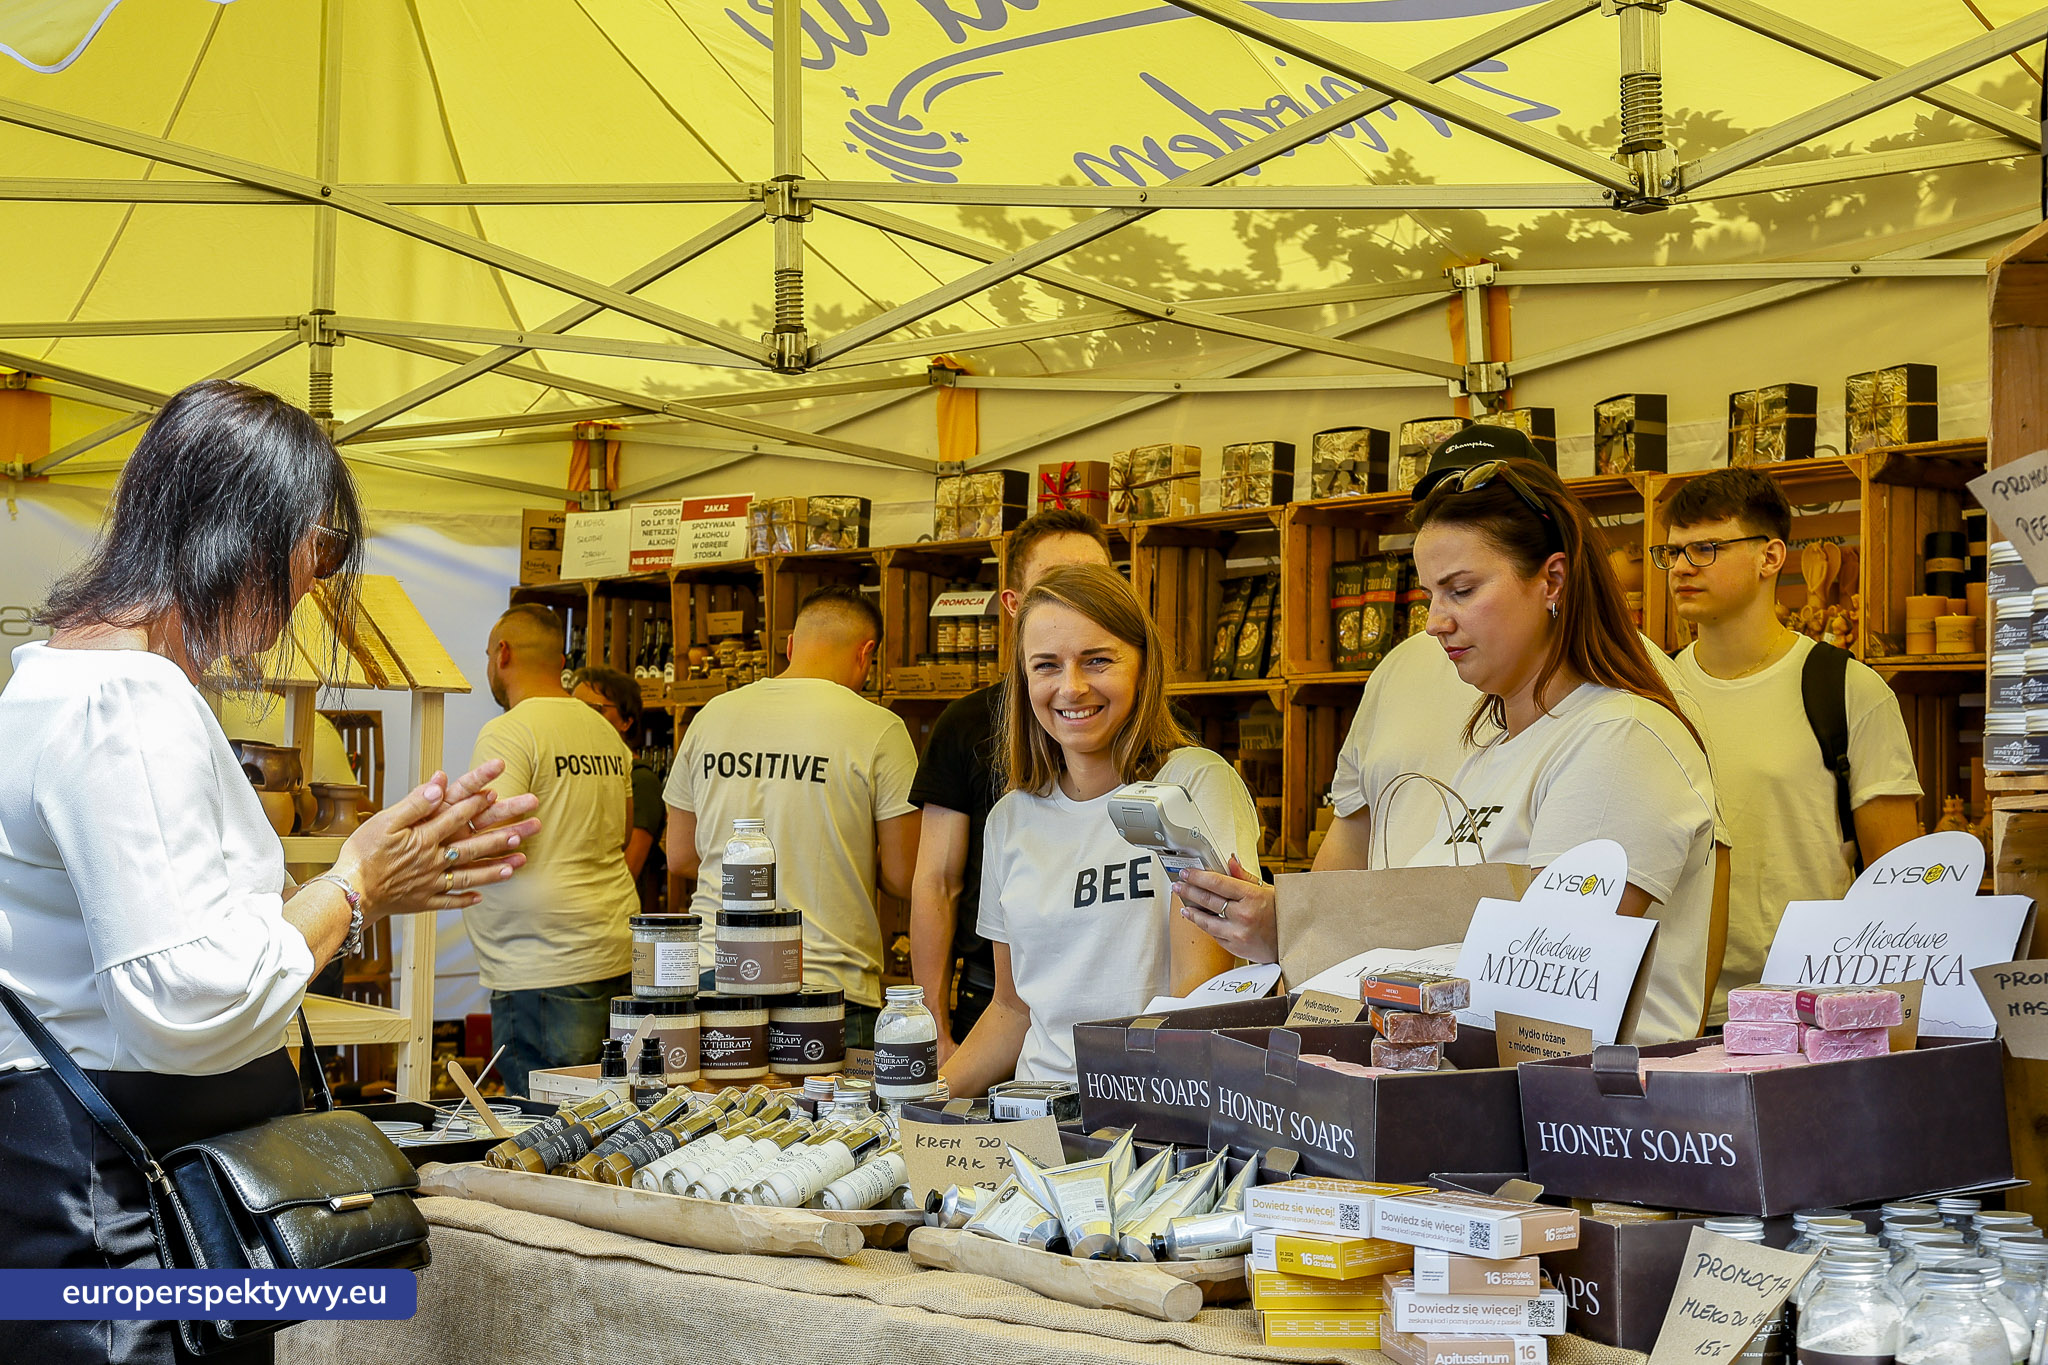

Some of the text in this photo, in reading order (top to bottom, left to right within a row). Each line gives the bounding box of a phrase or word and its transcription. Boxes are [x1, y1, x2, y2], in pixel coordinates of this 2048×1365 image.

[1445, 441, 1495, 454] Champion
[703, 503, 730, 513] ZAKAZ
[691, 521, 736, 530] SPOŻYWANIA
[694, 531, 730, 539] ALKOHOLU
[701, 540, 729, 549] OBRĘBIE
[632, 557, 645, 565] NIE
[693, 551, 722, 559] STOISKA
[937, 598, 985, 607] PROMOCJA
[554, 755, 624, 777] POSITIVE
[704, 752, 829, 784] POSITIVE
[1073, 856, 1155, 909] BEE
[1508, 926, 1592, 963] Miodowe
[1833, 920, 1948, 954] Miodowe
[1478, 953, 1600, 1002] MYDEŁKA
[1796, 953, 1966, 987] MYDEŁKA
[1518, 1026, 1566, 1045] Mydło różane
[710, 1040, 753, 1049] THERAPY
[1508, 1041, 1513, 1049] z
[1513, 1041, 1542, 1055] miodem
[1542, 1048, 1561, 1059] serce
[1085, 1072, 1210, 1108] HONEY SOAPS
[1218, 1085, 1355, 1159] HONEY SOAPS
[915, 1133, 1001, 1149] KREM DO
[1537, 1121, 1737, 1167] HONEY SOAPS
[946, 1155, 985, 1170] RĄK
[1252, 1198, 1336, 1219] Dowiedz się więcej!
[1381, 1211, 1465, 1236] Dowiedz się więcej!
[1544, 1227, 1575, 1242] 16 pastylek
[1300, 1252, 1313, 1266] 16
[1484, 1271, 1532, 1285] 16 pastylek
[1501, 1277, 1535, 1286] do ssania
[1693, 1253, 1792, 1298] PROMOCJA
[1408, 1303, 1522, 1317] Dowiedz się więcej!
[1469, 1318, 1496, 1326] produkty
[1519, 1345, 1537, 1360] 16
